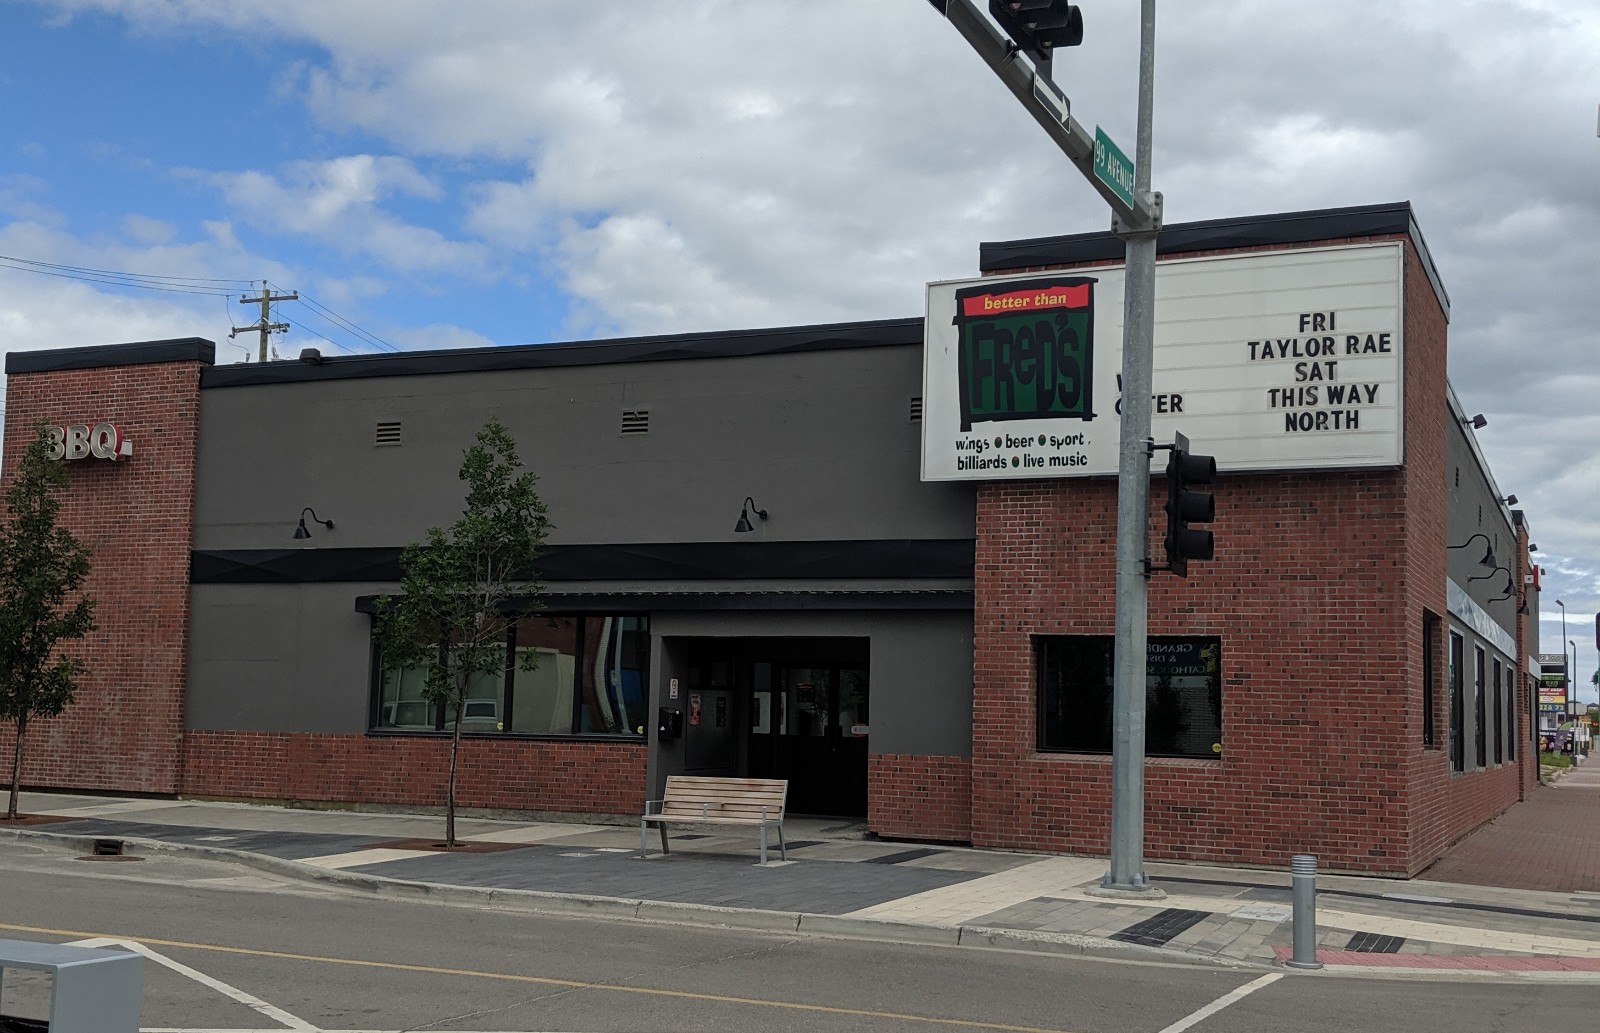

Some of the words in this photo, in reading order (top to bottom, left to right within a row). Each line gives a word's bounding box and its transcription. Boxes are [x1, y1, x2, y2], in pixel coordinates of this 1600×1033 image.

[1095, 140, 1105, 167] 99
[1107, 152, 1133, 196] AVENUE
[984, 297, 1030, 310] better
[1034, 293, 1067, 306] than
[1299, 312, 1335, 333] FRI
[1248, 336, 1336, 360] TAYLOR
[1346, 333, 1391, 354] RAE
[1295, 361, 1338, 382] SAT
[1267, 386, 1319, 408] THIS
[1327, 384, 1379, 405] WAY
[1285, 410, 1359, 432] NORTH
[45, 423, 118, 461] BBQ
[955, 436, 990, 453] wings
[1005, 434, 1034, 448] beer
[957, 455, 1007, 470] billiards
[1023, 453, 1045, 468] live
[1049, 451, 1088, 466] music
